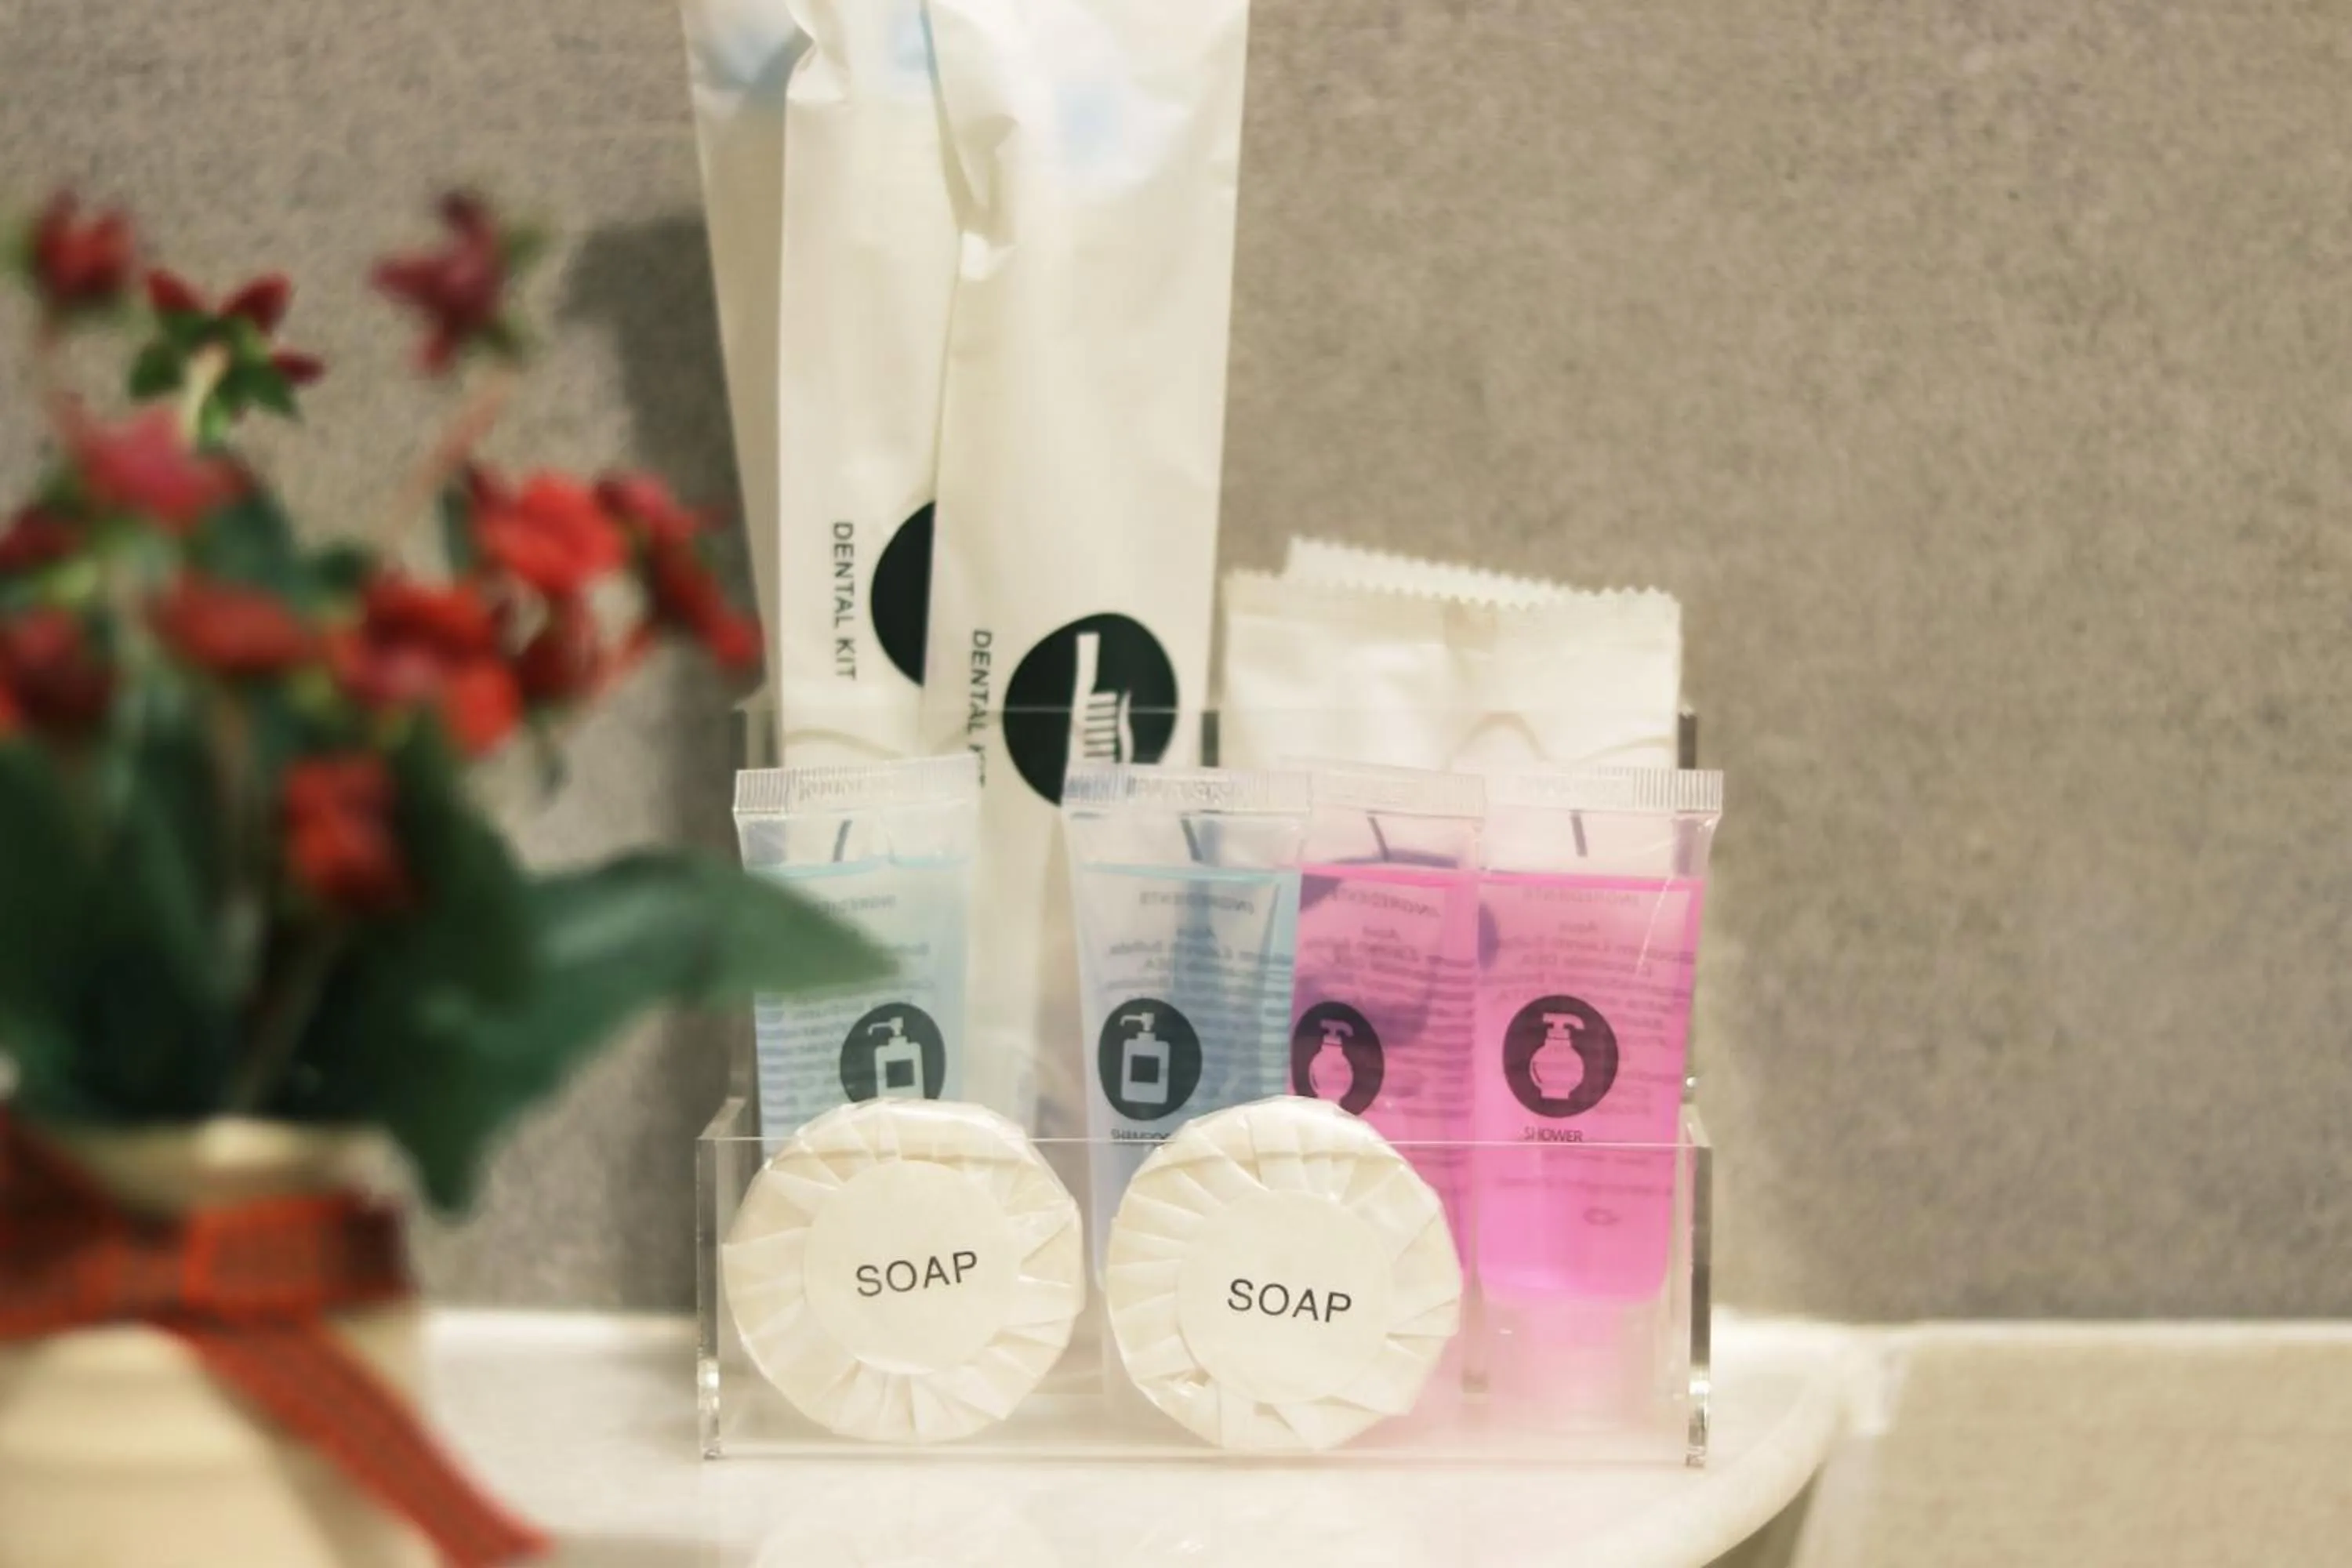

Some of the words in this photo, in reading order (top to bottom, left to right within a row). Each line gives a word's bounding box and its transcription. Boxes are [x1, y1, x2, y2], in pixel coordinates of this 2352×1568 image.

[833, 521, 855, 628] DENTAL
[836, 637, 857, 681] KIT
[966, 630, 993, 735] DENTAL
[1524, 1127, 1584, 1142] SHOWER
[855, 1250, 978, 1298] SOAP
[1227, 1278, 1352, 1323] SOAP
